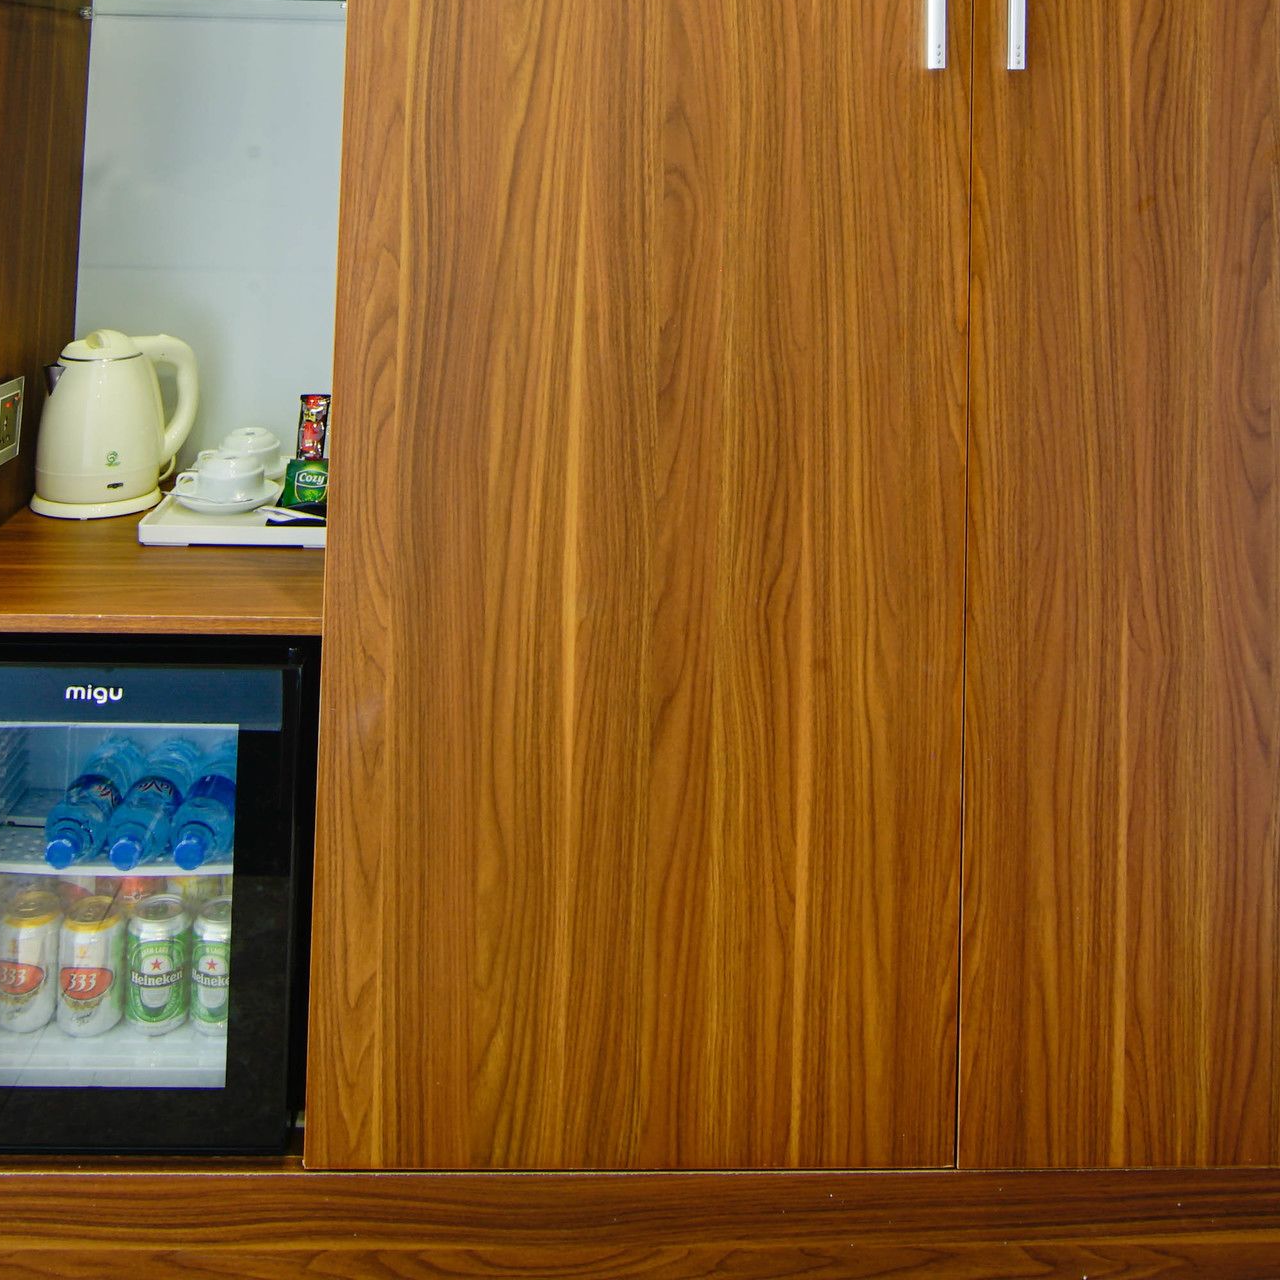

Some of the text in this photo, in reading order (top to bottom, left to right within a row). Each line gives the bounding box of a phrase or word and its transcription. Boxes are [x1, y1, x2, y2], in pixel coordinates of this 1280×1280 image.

[298, 472, 325, 485] Cozy
[65, 683, 124, 704] migu
[0, 967, 27, 987] 333
[67, 972, 96, 992] 333
[131, 969, 183, 986] Heineken
